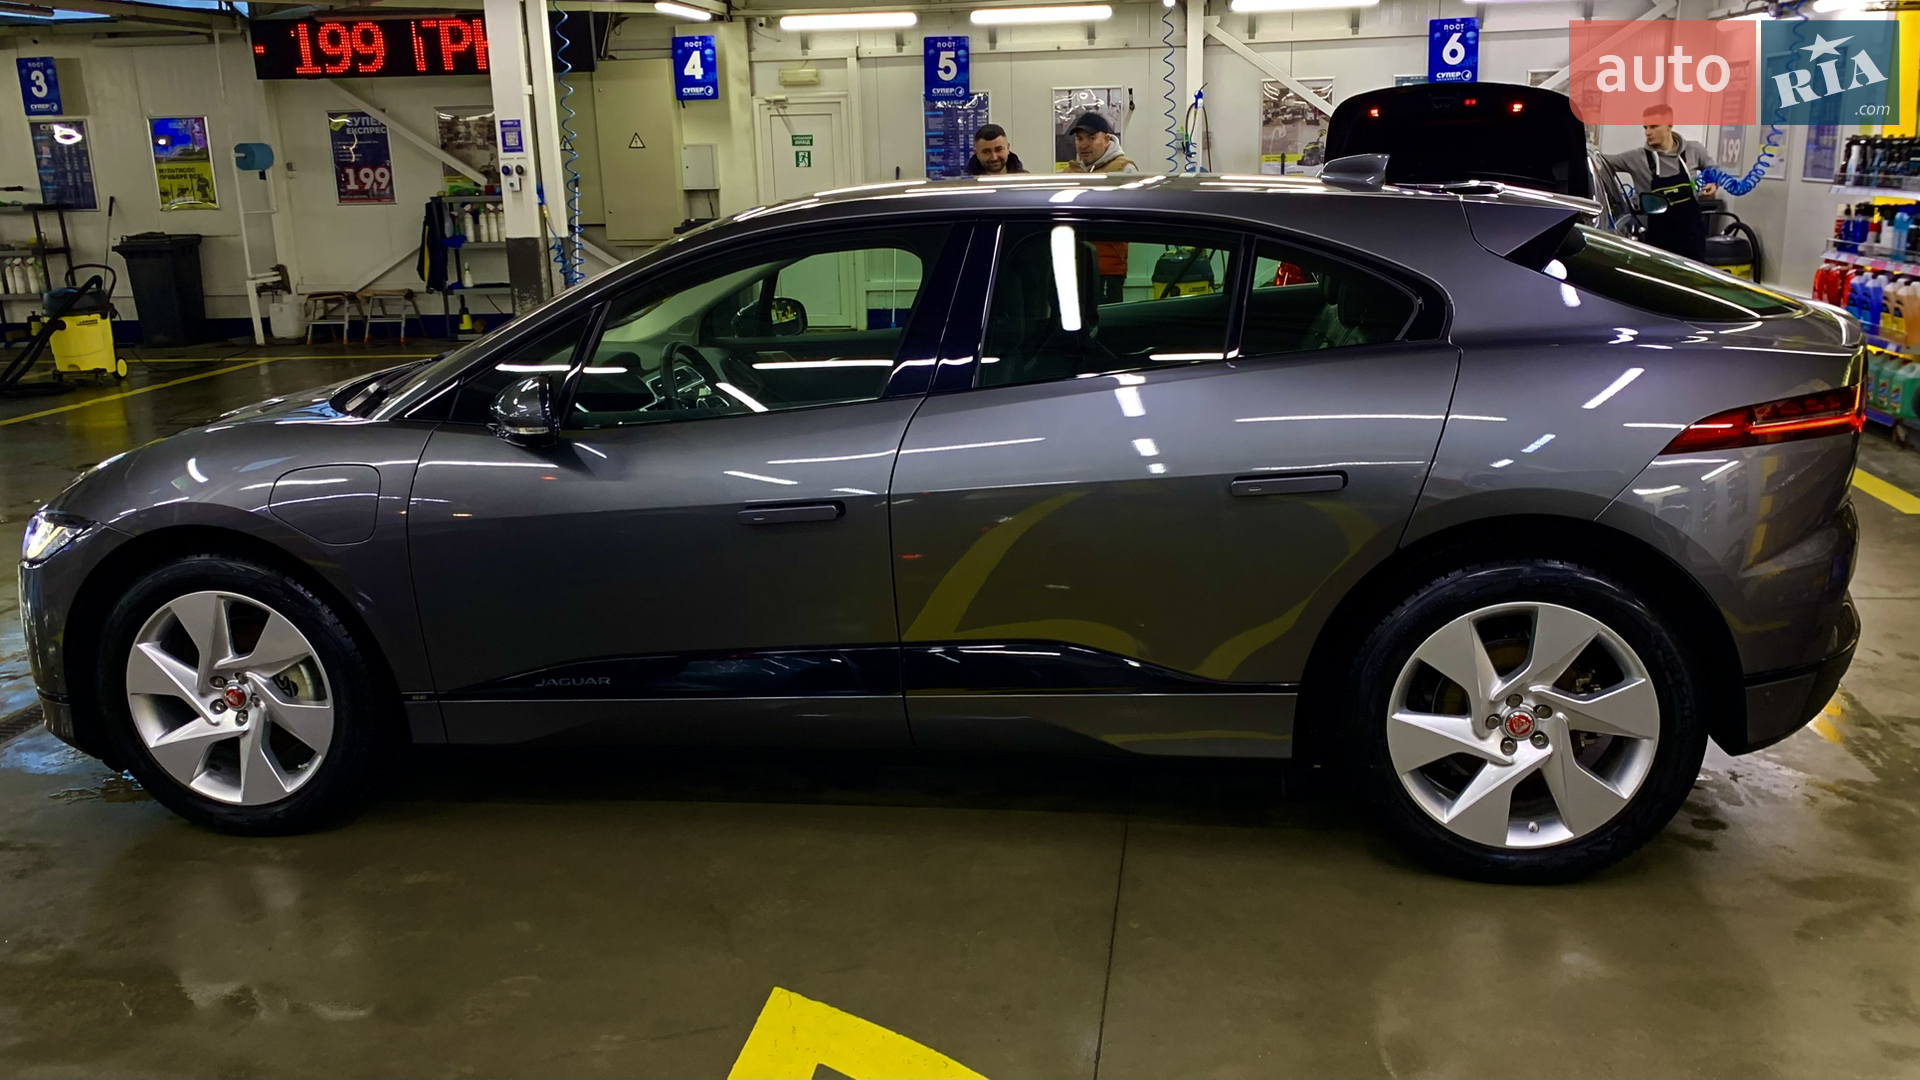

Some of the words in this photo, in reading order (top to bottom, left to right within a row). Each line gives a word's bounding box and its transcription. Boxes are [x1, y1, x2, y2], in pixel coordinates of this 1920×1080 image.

[1443, 23, 1465, 31] ПОСТ
[290, 21, 386, 74] 199
[684, 40, 703, 48] ПОСТ
[1442, 32, 1466, 66] 6
[683, 50, 704, 80] 4
[937, 51, 958, 82] 5
[1435, 71, 1462, 79] СУПЕР
[30, 69, 49, 98] 3
[682, 86, 705, 94] СУПЕР
[346, 116, 382, 126] СУПЕ
[1722, 138, 1742, 163] 199
[345, 167, 390, 190] 199
[535, 677, 611, 687] JAGUAR
